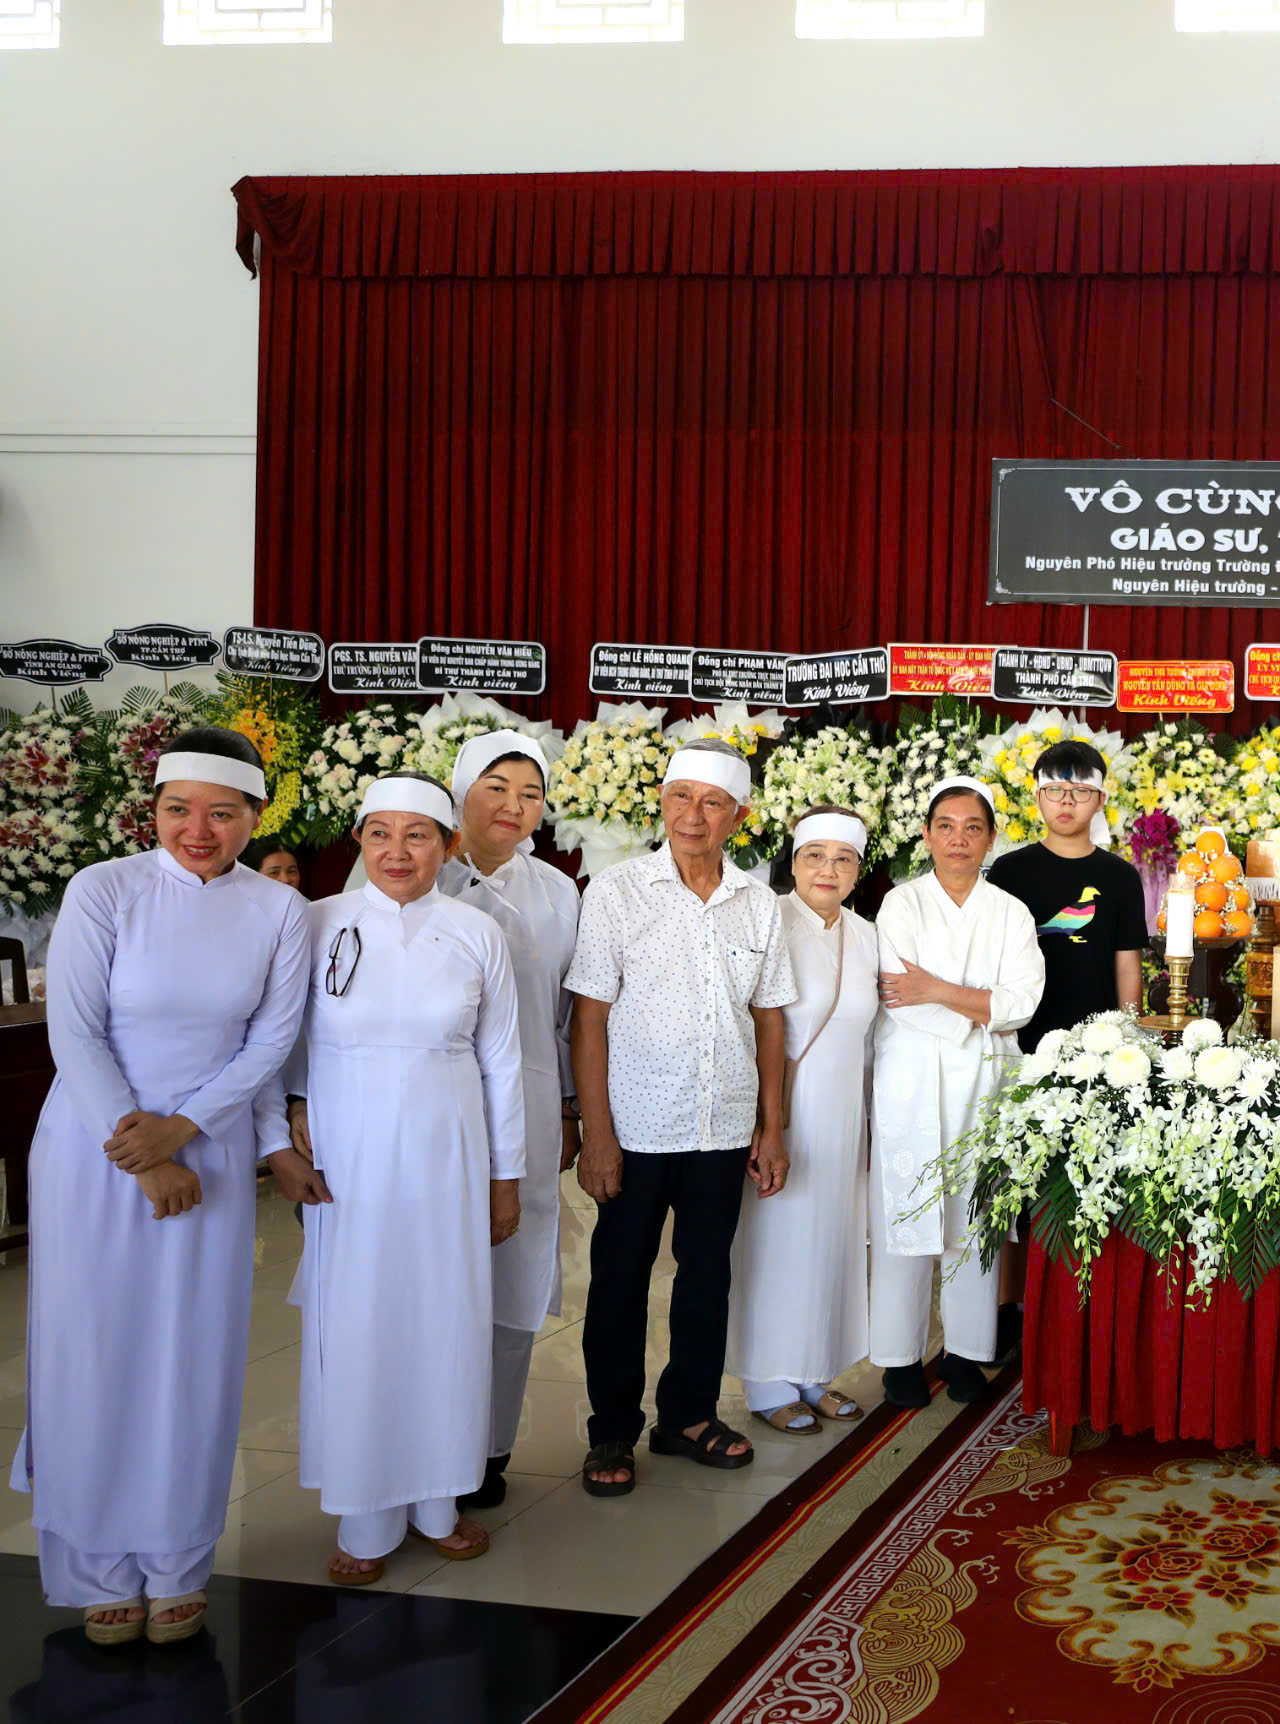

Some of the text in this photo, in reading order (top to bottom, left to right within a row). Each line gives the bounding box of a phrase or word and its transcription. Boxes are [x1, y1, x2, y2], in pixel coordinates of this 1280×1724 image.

[1065, 480, 1143, 514] VÔ
[1110, 523, 1205, 552] GIÁO
[1213, 527, 1269, 555] SƯ,
[1025, 556, 1081, 571] Nguyên
[1087, 557, 1115, 569] Phó
[1121, 557, 1155, 573] Hiệu
[1161, 558, 1211, 574] trưởng
[1216, 559, 1270, 574] Trường
[1112, 578, 1168, 594] Nguyên
[1175, 579, 1209, 595] Hiệu
[1215, 580, 1265, 596] trưởng
[335, 651, 352, 662] PGS.
[355, 651, 367, 662] TS.
[369, 648, 400, 662] NGUYỄN
[431, 644, 532, 657] Đồng chí NGUYỄN VĂN HIẾU
[599, 650, 618, 663] Đồng
[619, 651, 631, 662] chí
[633, 650, 642, 662] LÊ
[643, 650, 664, 663] HỒNG
[787, 653, 885, 682] TRƯỜNG ĐẠI HỌC CẦN THƠ
[1015, 670, 1095, 687] THÀNH PHỐ CẦN THƠ
[803, 681, 870, 701] Kính Viếng
